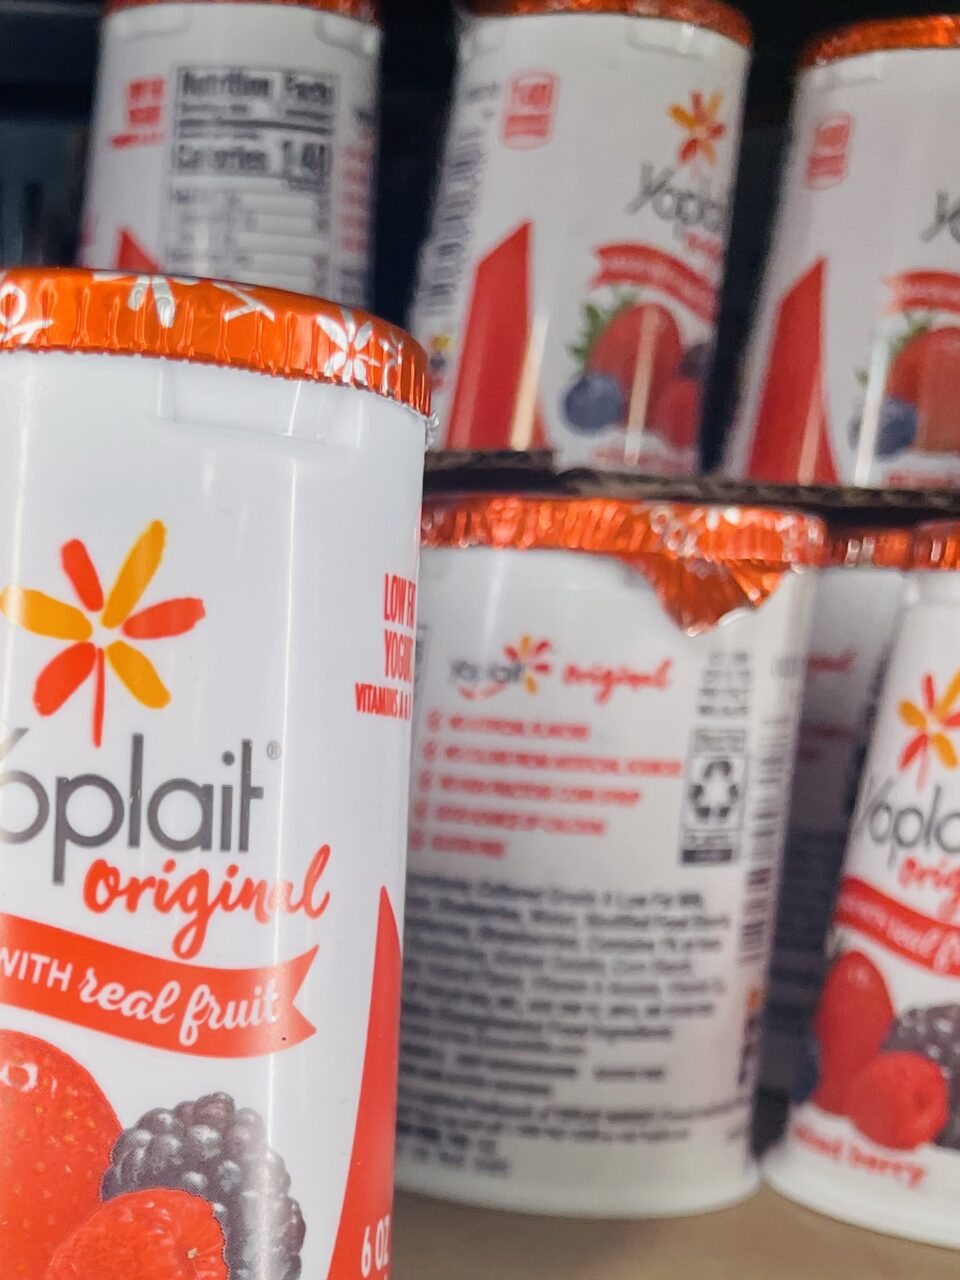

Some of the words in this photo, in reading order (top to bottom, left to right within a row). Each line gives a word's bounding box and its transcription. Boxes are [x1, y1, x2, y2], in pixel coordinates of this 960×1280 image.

[82, 843, 331, 960] original
[78, 967, 180, 1025] real
[176, 984, 280, 1047] fruit
[361, 1225, 372, 1279] 6
